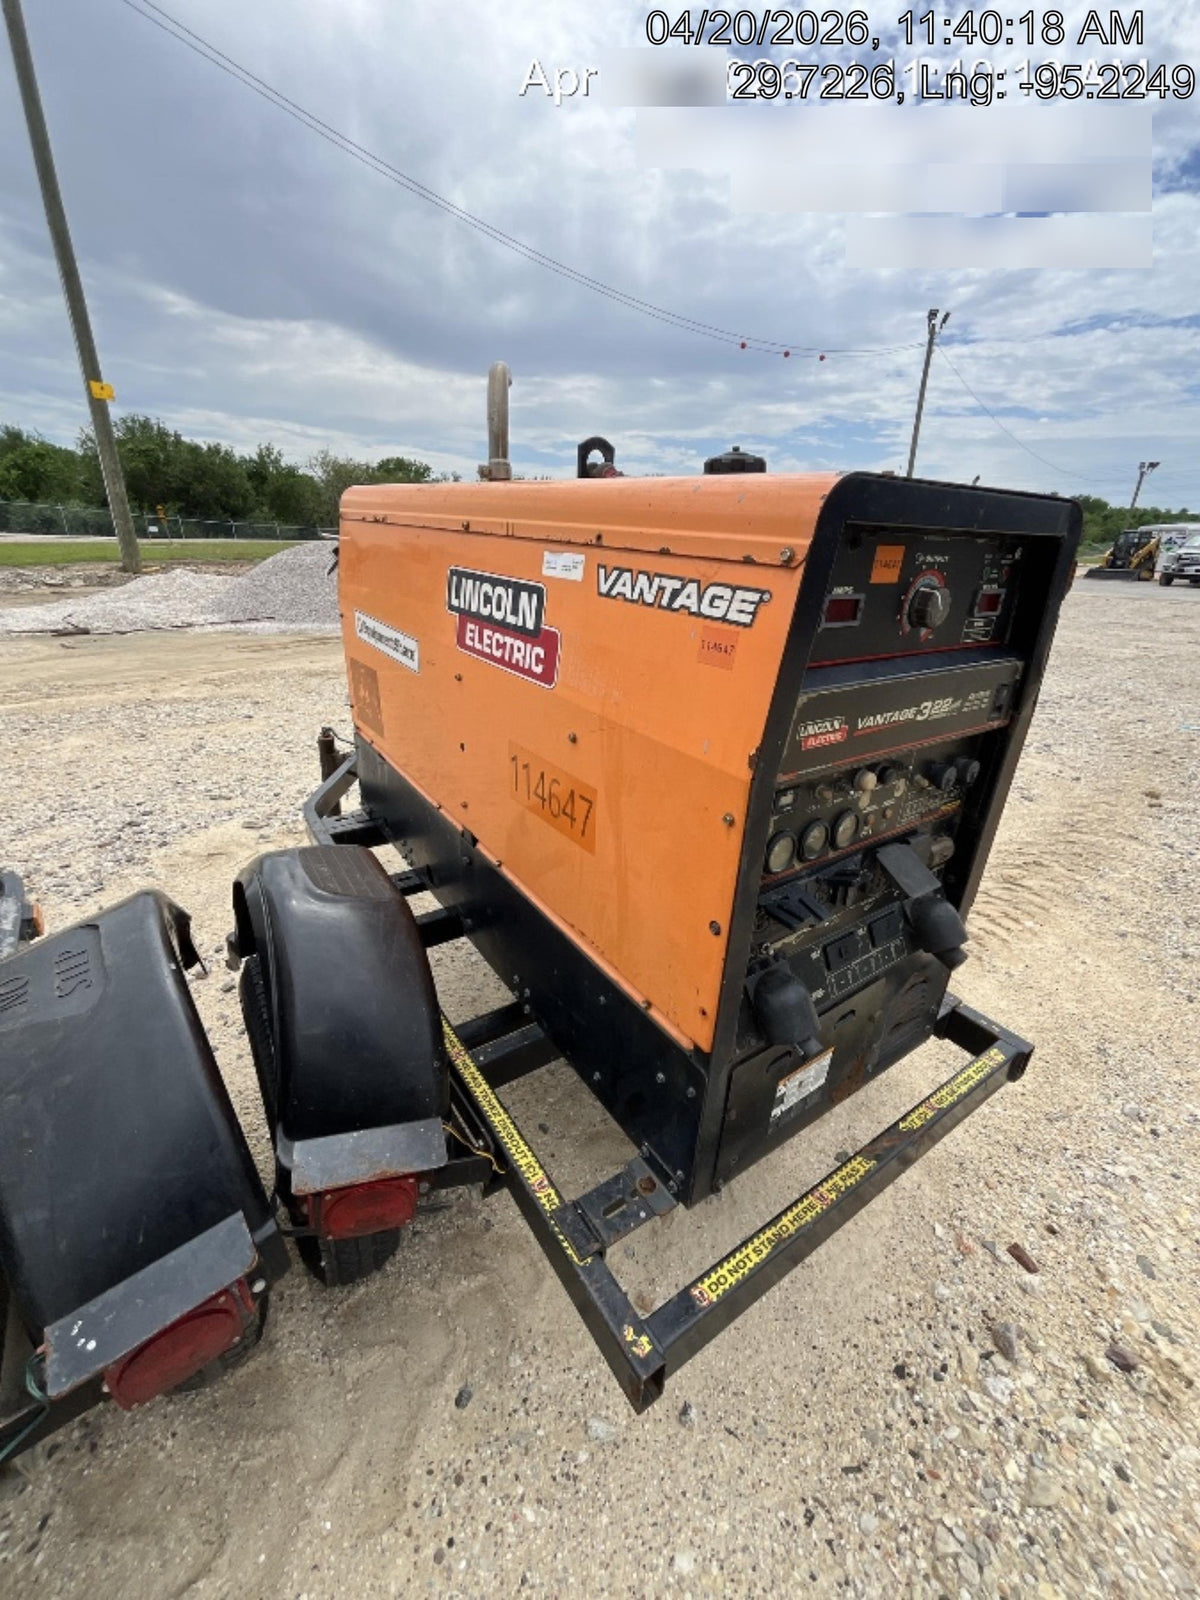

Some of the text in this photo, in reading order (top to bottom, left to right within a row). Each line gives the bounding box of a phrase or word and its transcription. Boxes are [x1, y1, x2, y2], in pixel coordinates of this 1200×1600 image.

[450, 575, 538, 630] LINCOLN
[465, 621, 545, 674] ELECTRIC
[511, 754, 593, 837] 114647
[707, 1273, 728, 1293] DO
[726, 1252, 754, 1277] NOT
[752, 1223, 790, 1256] STAND
[787, 1200, 818, 1226] HERE
